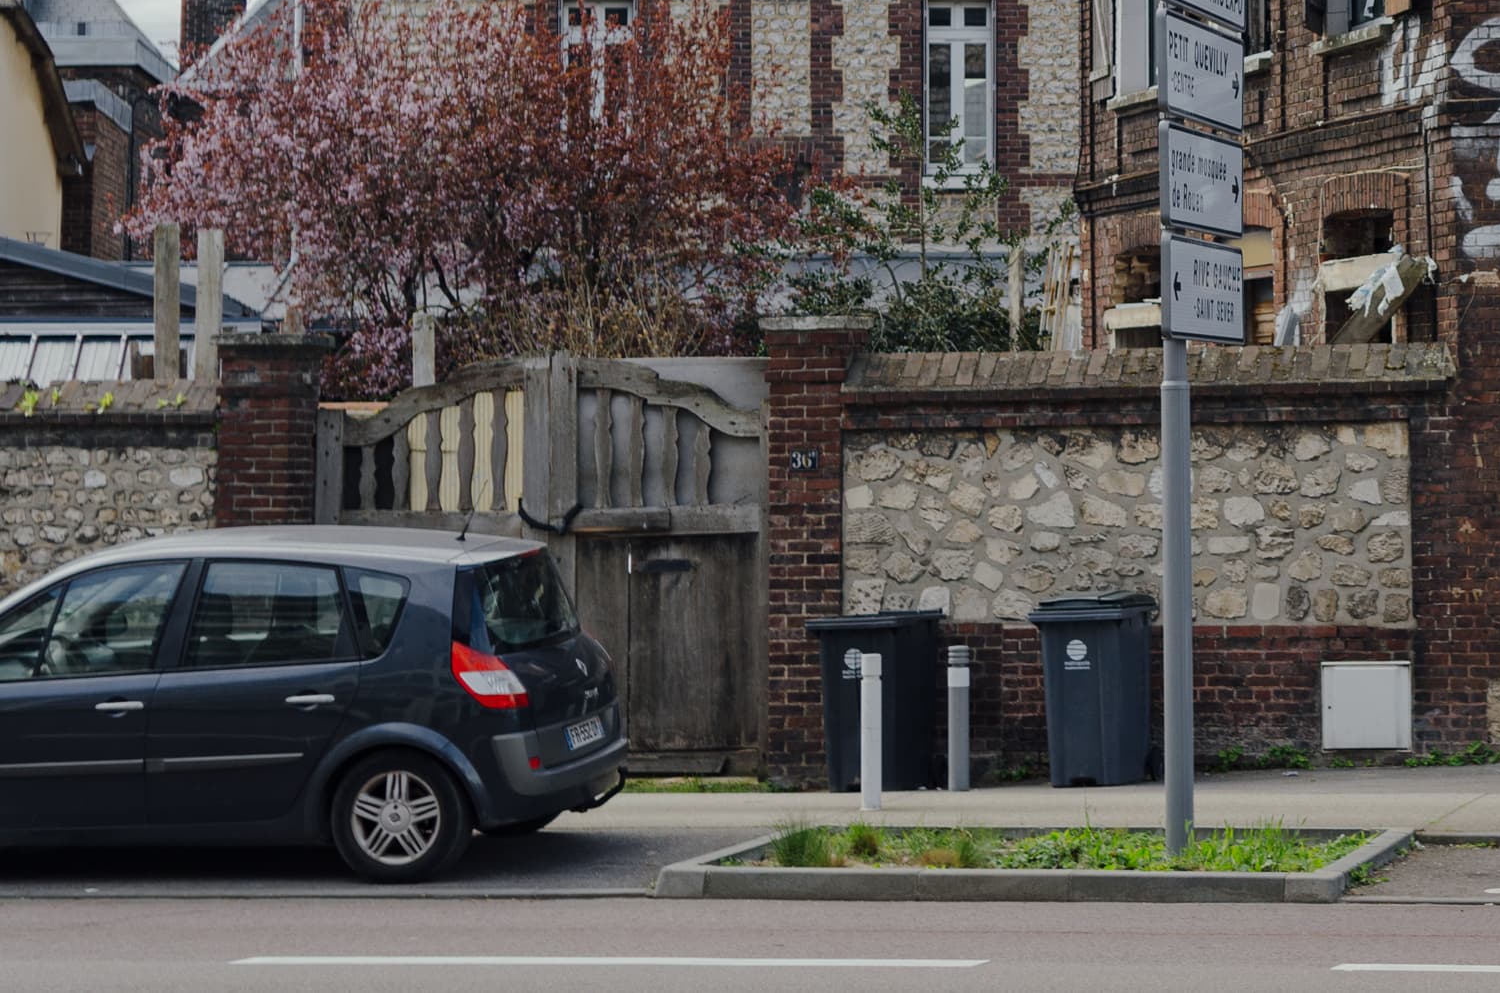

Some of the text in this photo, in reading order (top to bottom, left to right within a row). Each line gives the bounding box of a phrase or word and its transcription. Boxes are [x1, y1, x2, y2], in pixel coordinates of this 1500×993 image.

[1168, 29, 1229, 79] PETIT QUEVILLY
[1171, 145, 1227, 186] grande mosquée
[1171, 180, 1181, 209] de
[1193, 258, 1241, 293] RIVE GAUCHE
[1216, 300, 1234, 323] SEVER
